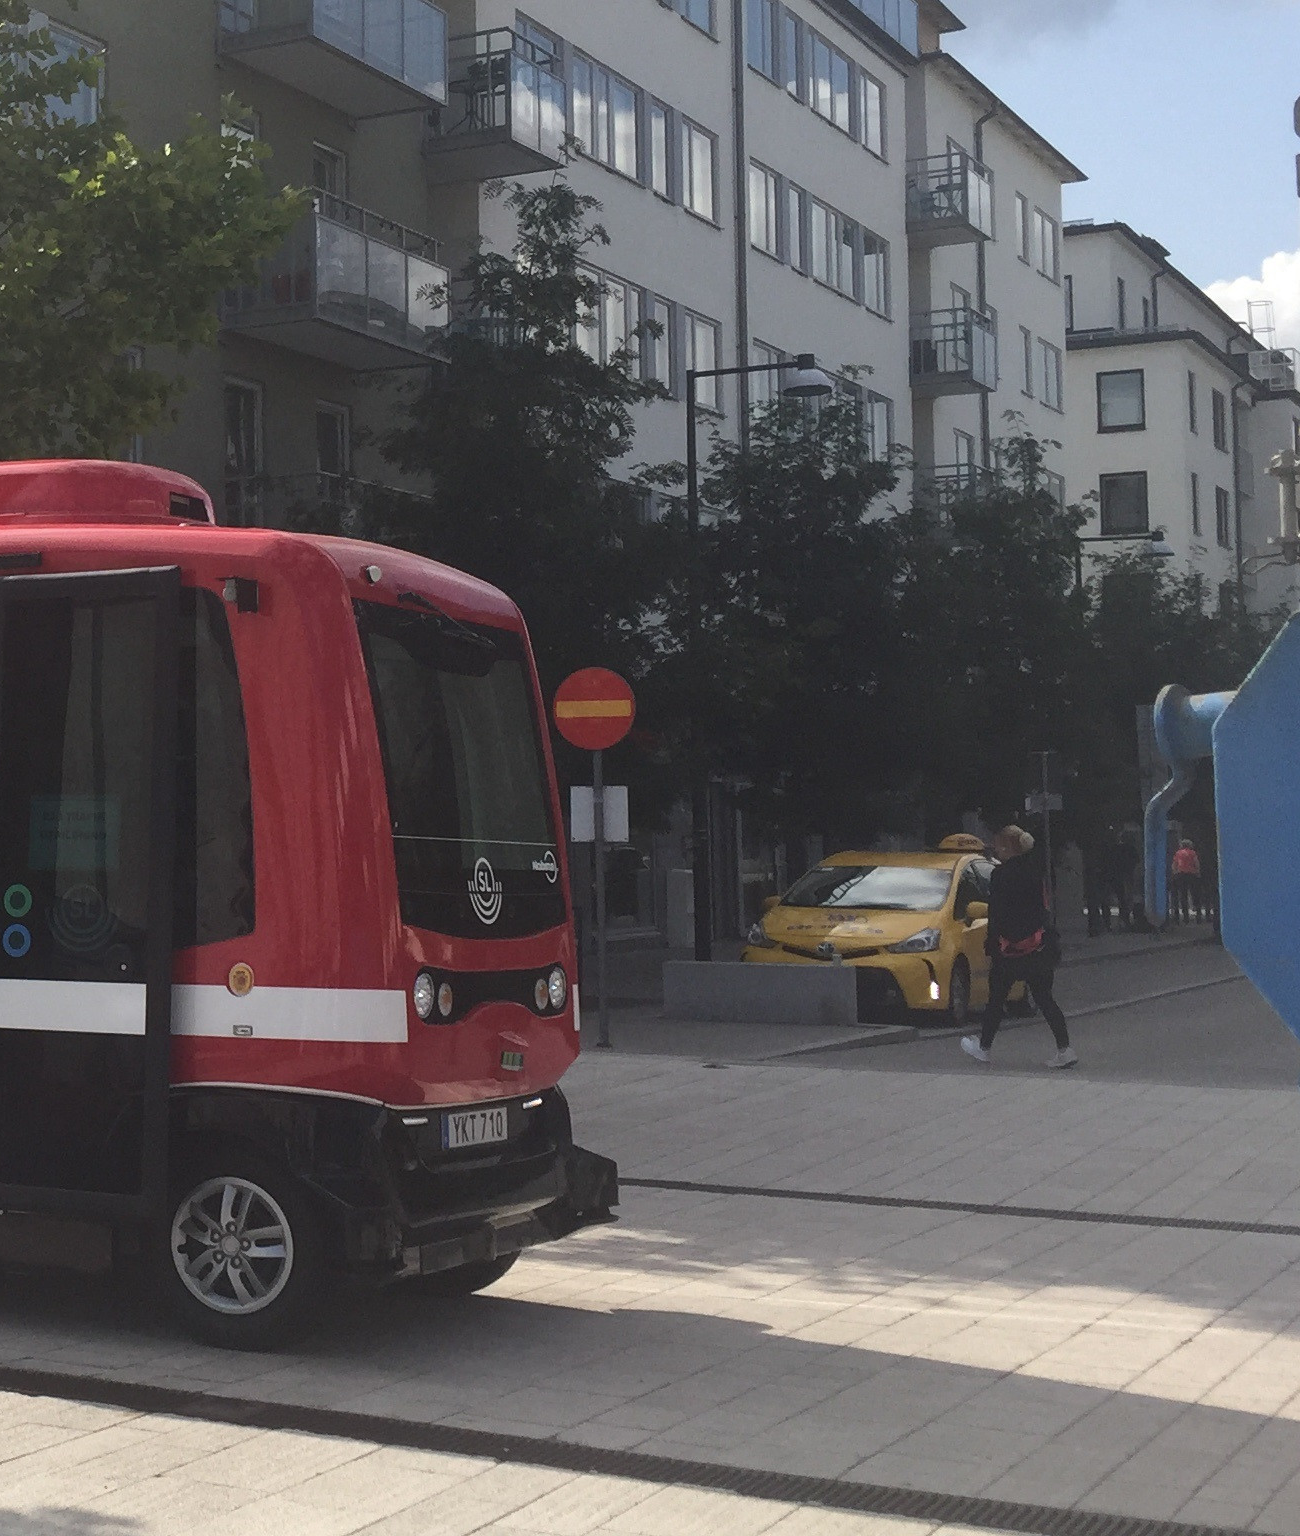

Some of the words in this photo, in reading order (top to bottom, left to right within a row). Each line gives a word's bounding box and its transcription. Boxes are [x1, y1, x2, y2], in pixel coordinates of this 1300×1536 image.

[478, 871, 492, 892] SL
[453, 1114, 477, 1144] YKT
[481, 1110, 504, 1140] 710
